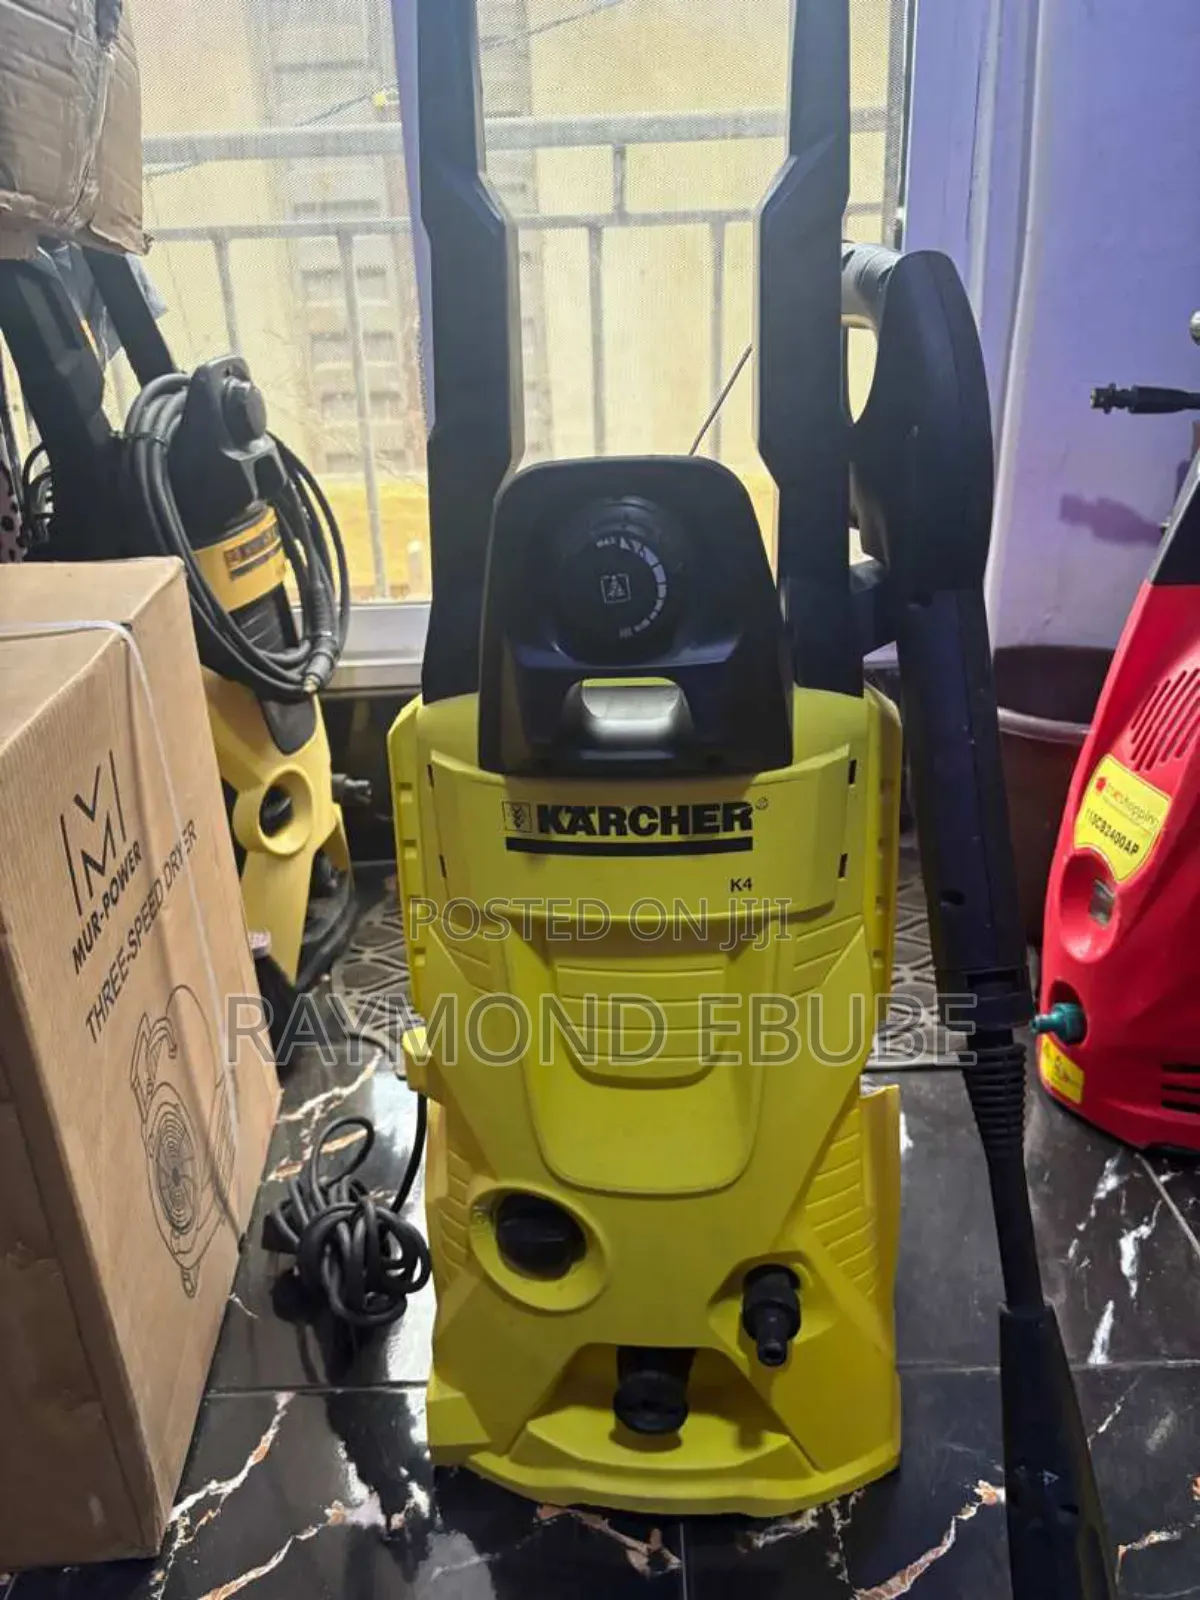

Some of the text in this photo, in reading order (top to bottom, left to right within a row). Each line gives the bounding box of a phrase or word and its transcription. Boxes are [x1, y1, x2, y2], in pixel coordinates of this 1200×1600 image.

[71, 839, 142, 975] MUR-POWER
[730, 877, 752, 893] K4
[85, 880, 163, 1044] THREE-SPEED
